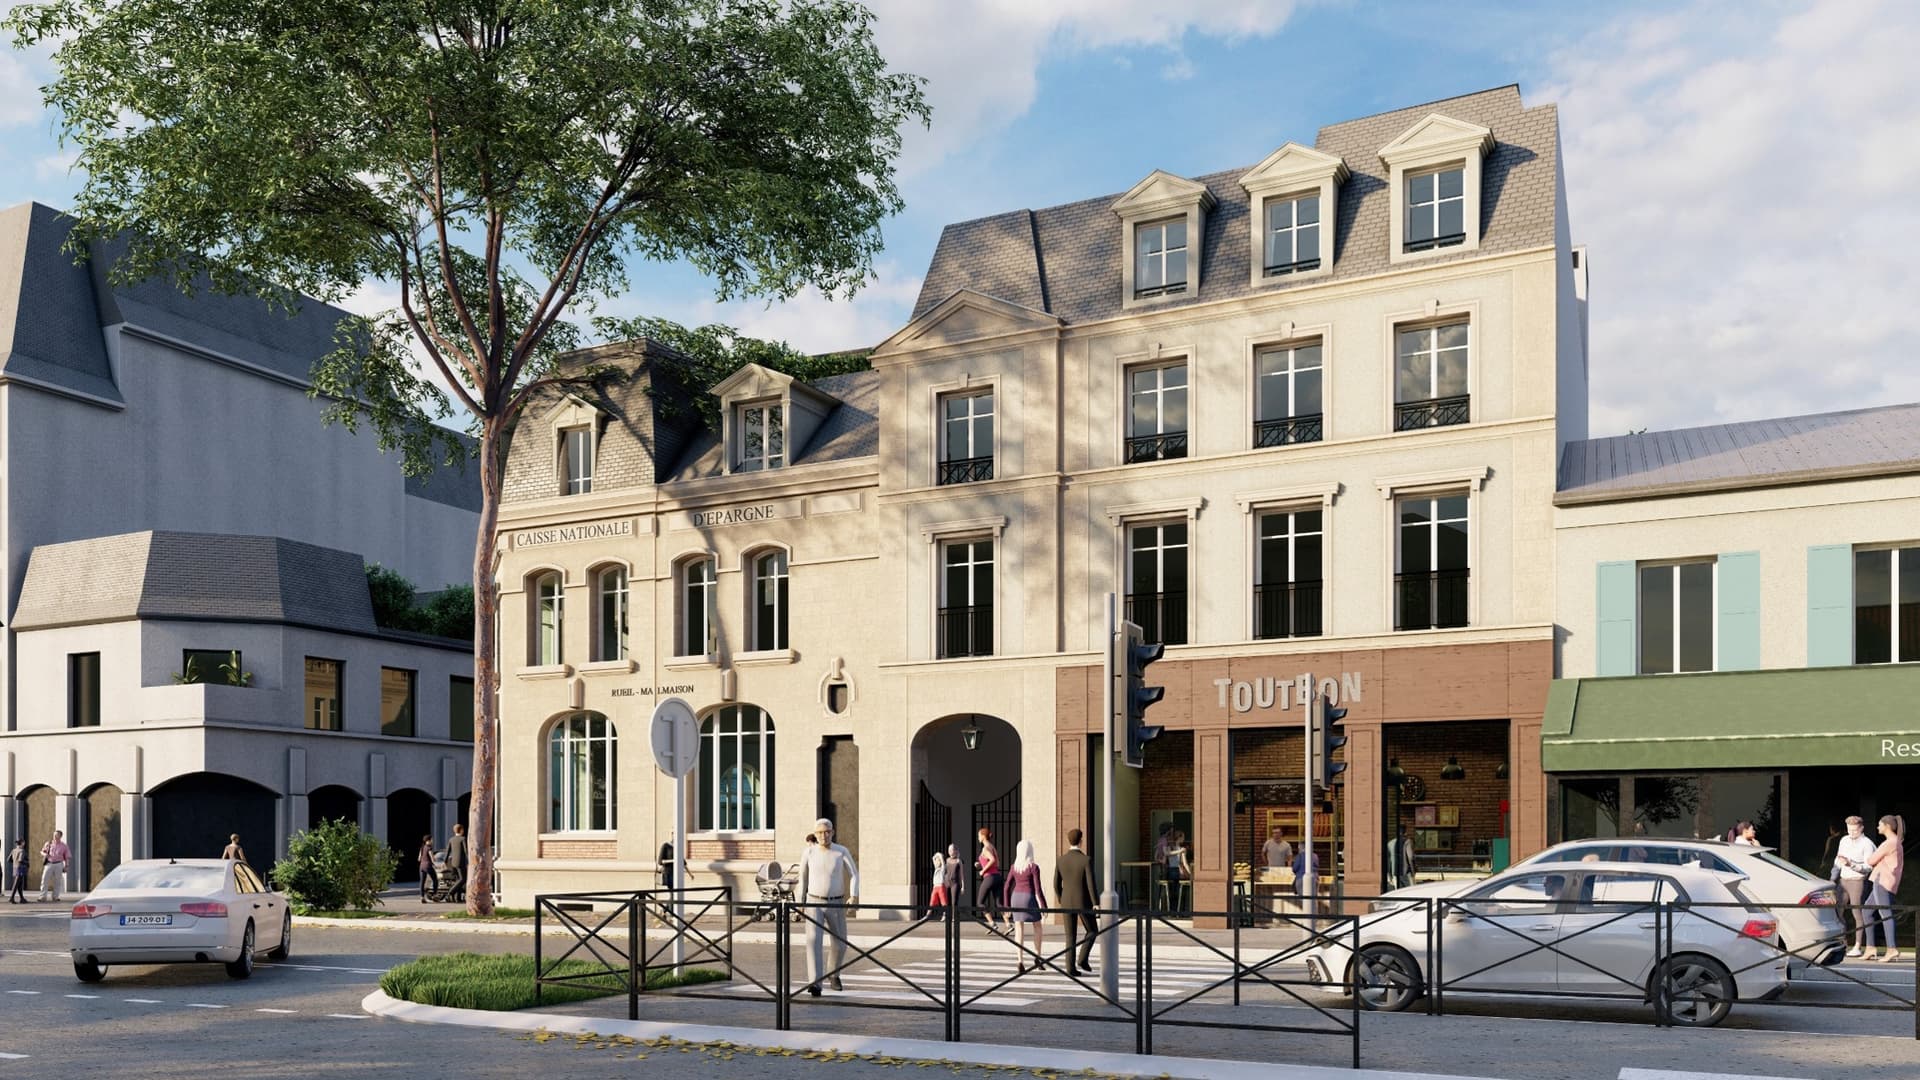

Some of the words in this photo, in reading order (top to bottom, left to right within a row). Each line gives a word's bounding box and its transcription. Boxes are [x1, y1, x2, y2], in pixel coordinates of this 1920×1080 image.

[693, 504, 775, 528] D'EPARGNE
[517, 530, 557, 546] CAISSE
[559, 521, 629, 541] NATIONALE
[1213, 671, 1361, 713] TOUTBON
[1881, 739, 1920, 757] Res
